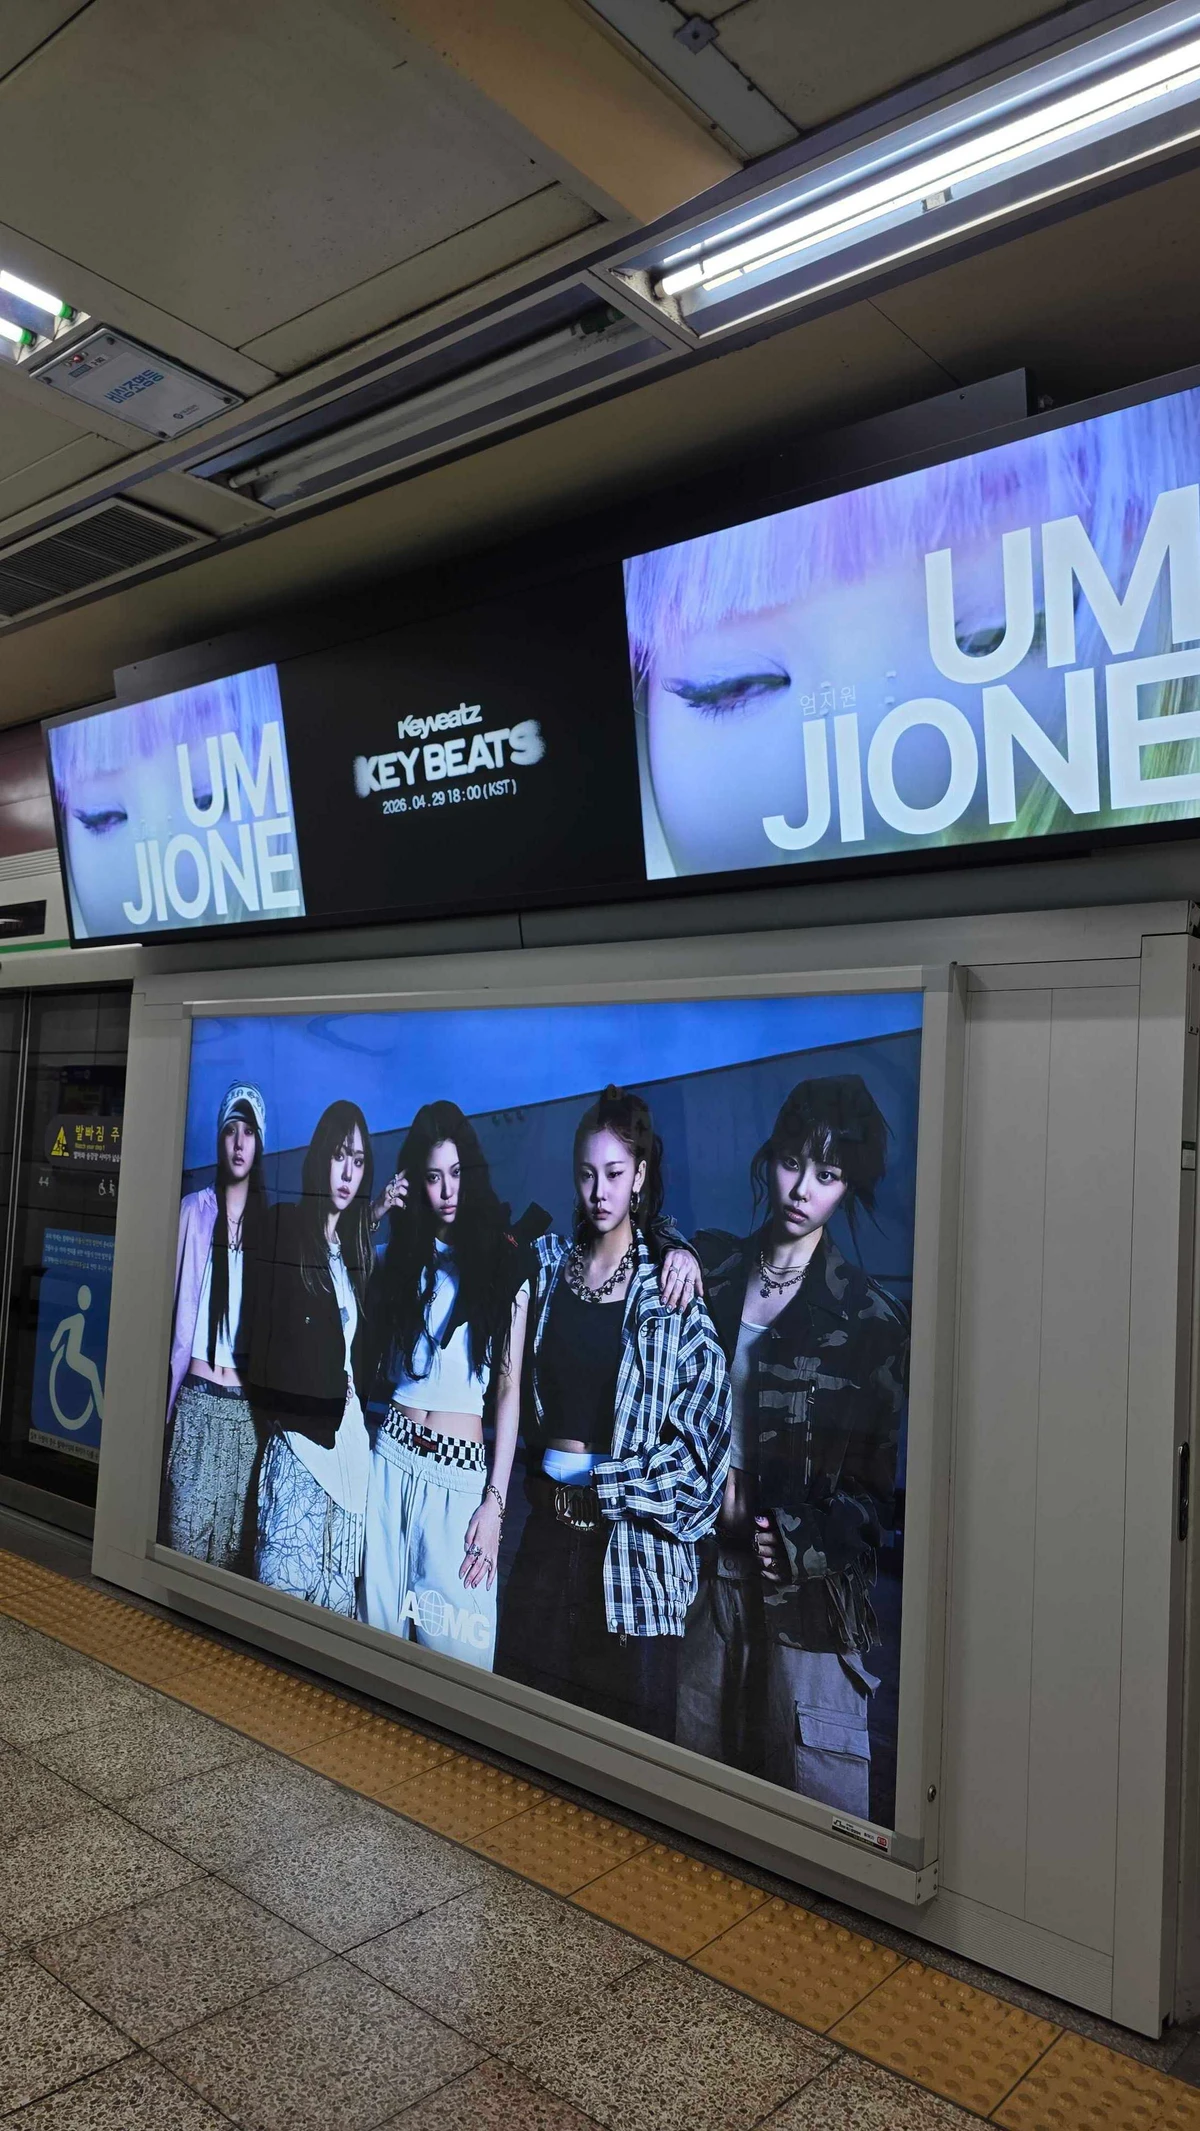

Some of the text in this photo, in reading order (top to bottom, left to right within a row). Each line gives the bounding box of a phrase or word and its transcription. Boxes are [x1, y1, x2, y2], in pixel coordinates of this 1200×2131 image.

[104, 369, 164, 404] 비상조명등
[925, 483, 1200, 684] UM
[800, 685, 857, 716] 엄지원
[176, 721, 288, 828] UM
[353, 719, 547, 799] KEY BEATS
[762, 648, 1200, 851] JIONE
[122, 816, 300, 925] JIONE
[75, 1124, 106, 1142] 발빠짐
